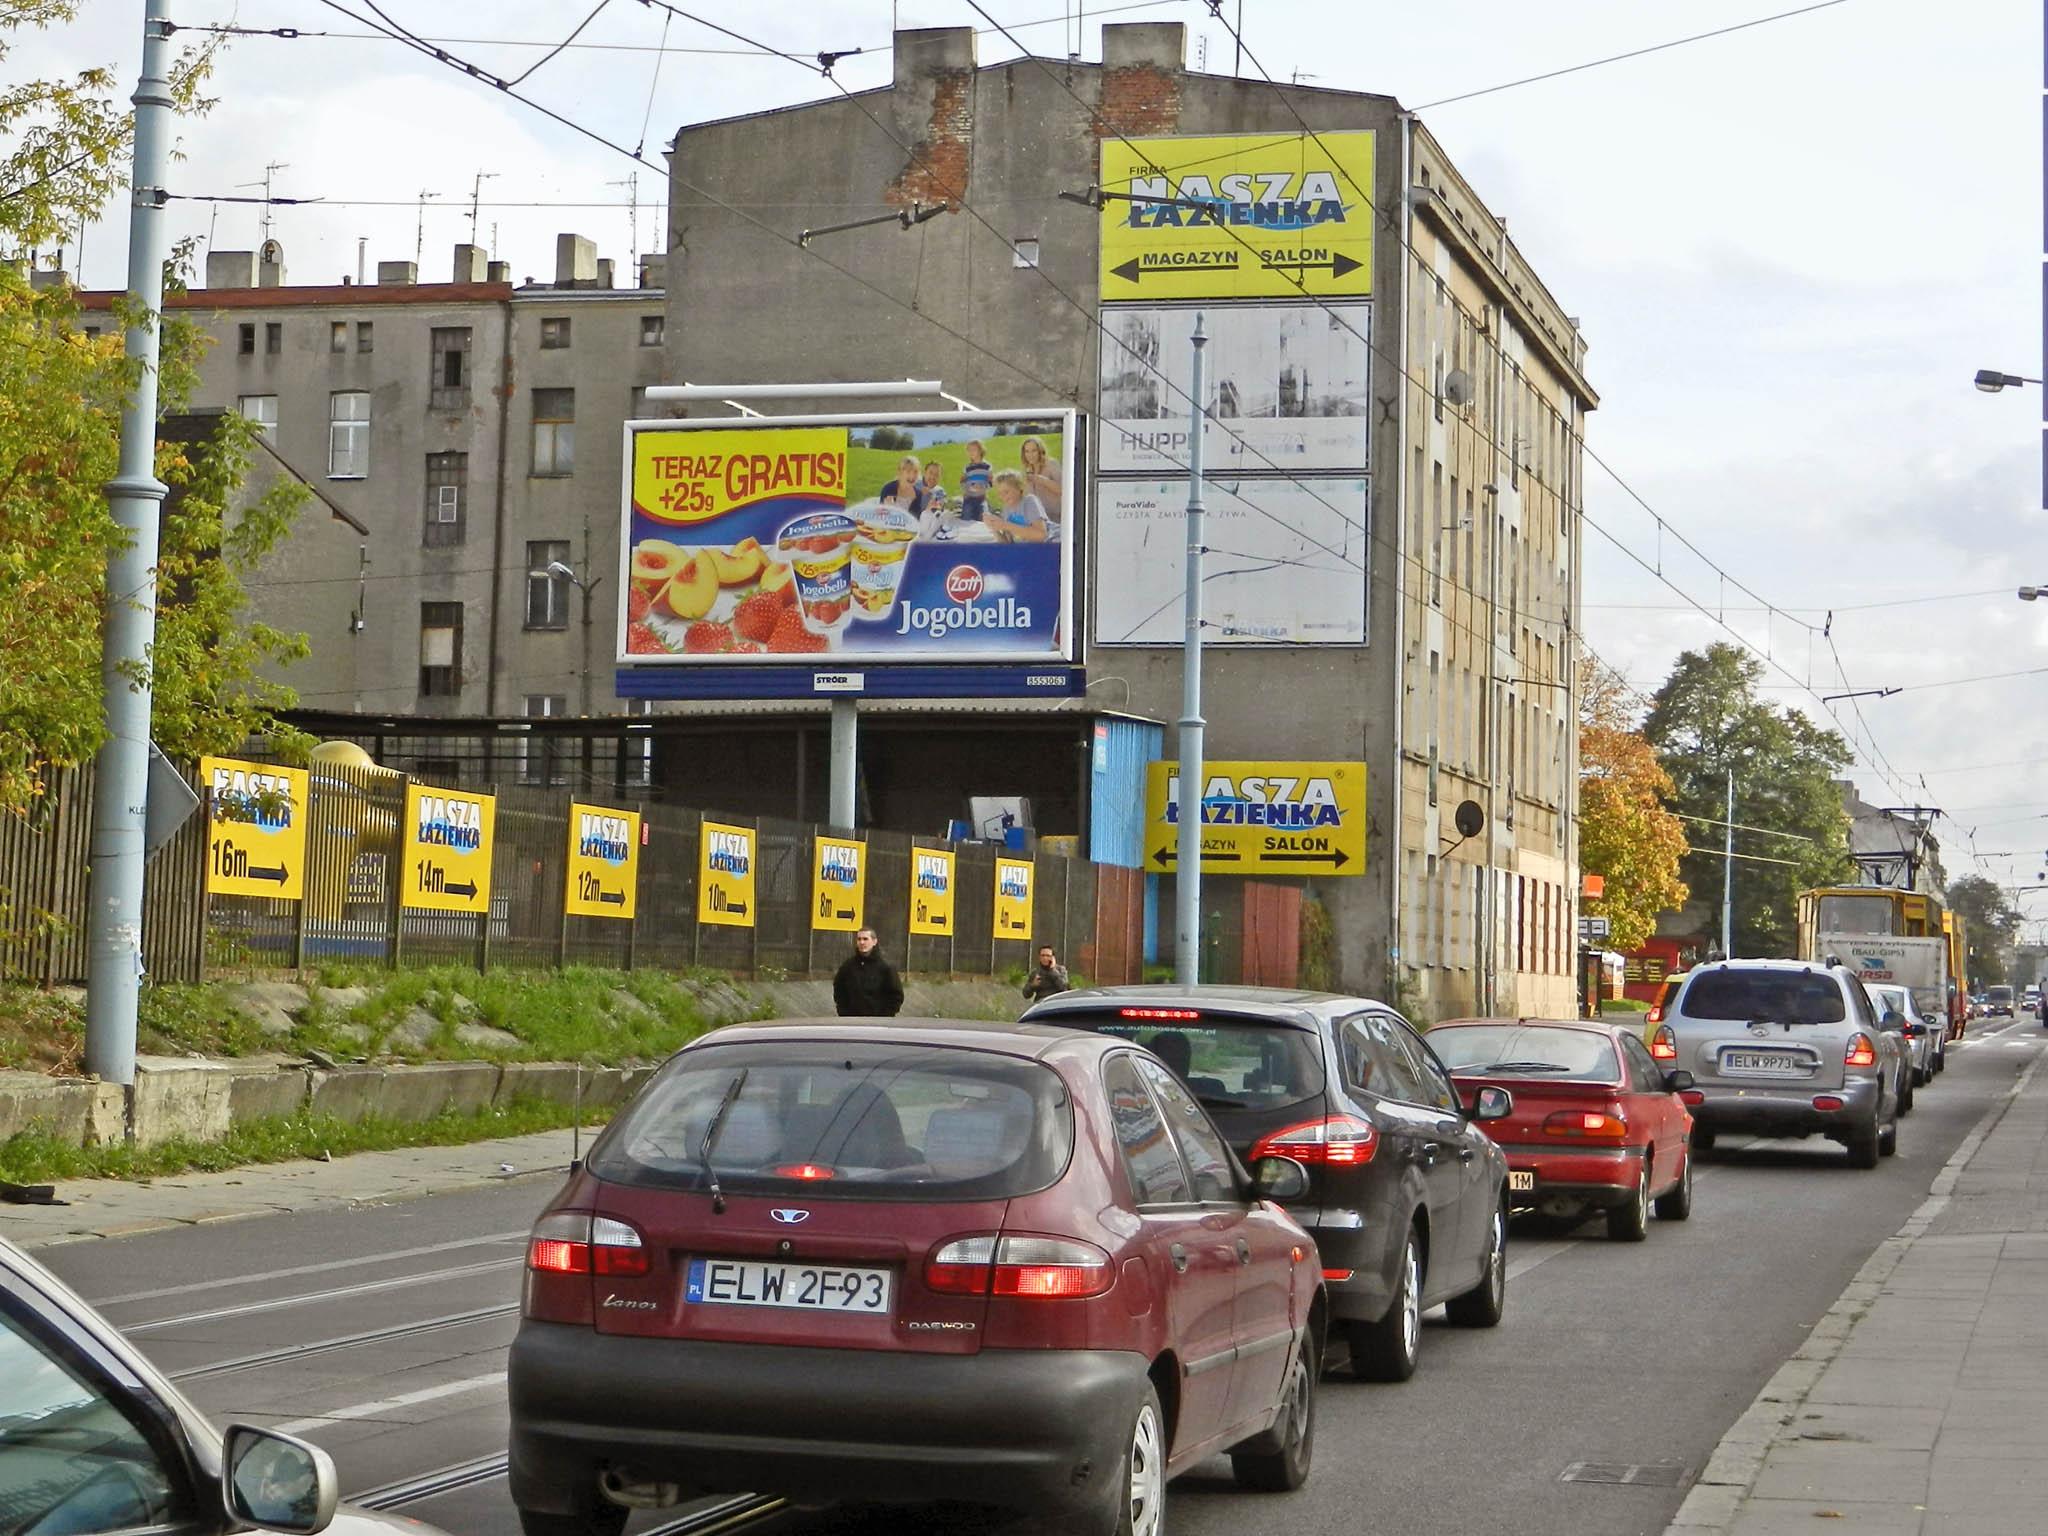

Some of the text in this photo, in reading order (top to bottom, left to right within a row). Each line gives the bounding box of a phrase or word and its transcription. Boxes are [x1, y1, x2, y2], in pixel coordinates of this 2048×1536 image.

[1129, 165, 1167, 176] FIRMA
[1130, 171, 1344, 206] NASZA
[1129, 200, 1346, 228] ŁAZIENKA
[1143, 249, 1328, 265] MAGAZYN SALON
[1120, 432, 1192, 450] HÜPP
[652, 452, 844, 501] TERAZ GRATIS!
[659, 482, 714, 512] +25g
[787, 518, 849, 535] Jogobella
[801, 579, 847, 598] Jogobella
[950, 575, 982, 592] Zott
[896, 598, 1032, 638] Jogobella
[420, 795, 481, 830] NASZA
[580, 812, 629, 841] NASZA
[418, 821, 480, 849] ŁAZIENKA
[709, 830, 749, 858] NASZA
[1265, 837, 1328, 851] SALON
[212, 839, 247, 878] 16m
[822, 844, 858, 869] NASZA
[417, 860, 445, 893] 14m
[578, 870, 600, 902] 12m
[708, 883, 727, 912] 10m
[820, 892, 832, 918] 8m
[1734, 1055, 1791, 1069] ELW 9P73
[689, 1284, 701, 1295] PL
[709, 1264, 884, 1307] ELW 2F93
[602, 1294, 657, 1309] Lanos
[909, 1322, 976, 1330] DAEWOO
